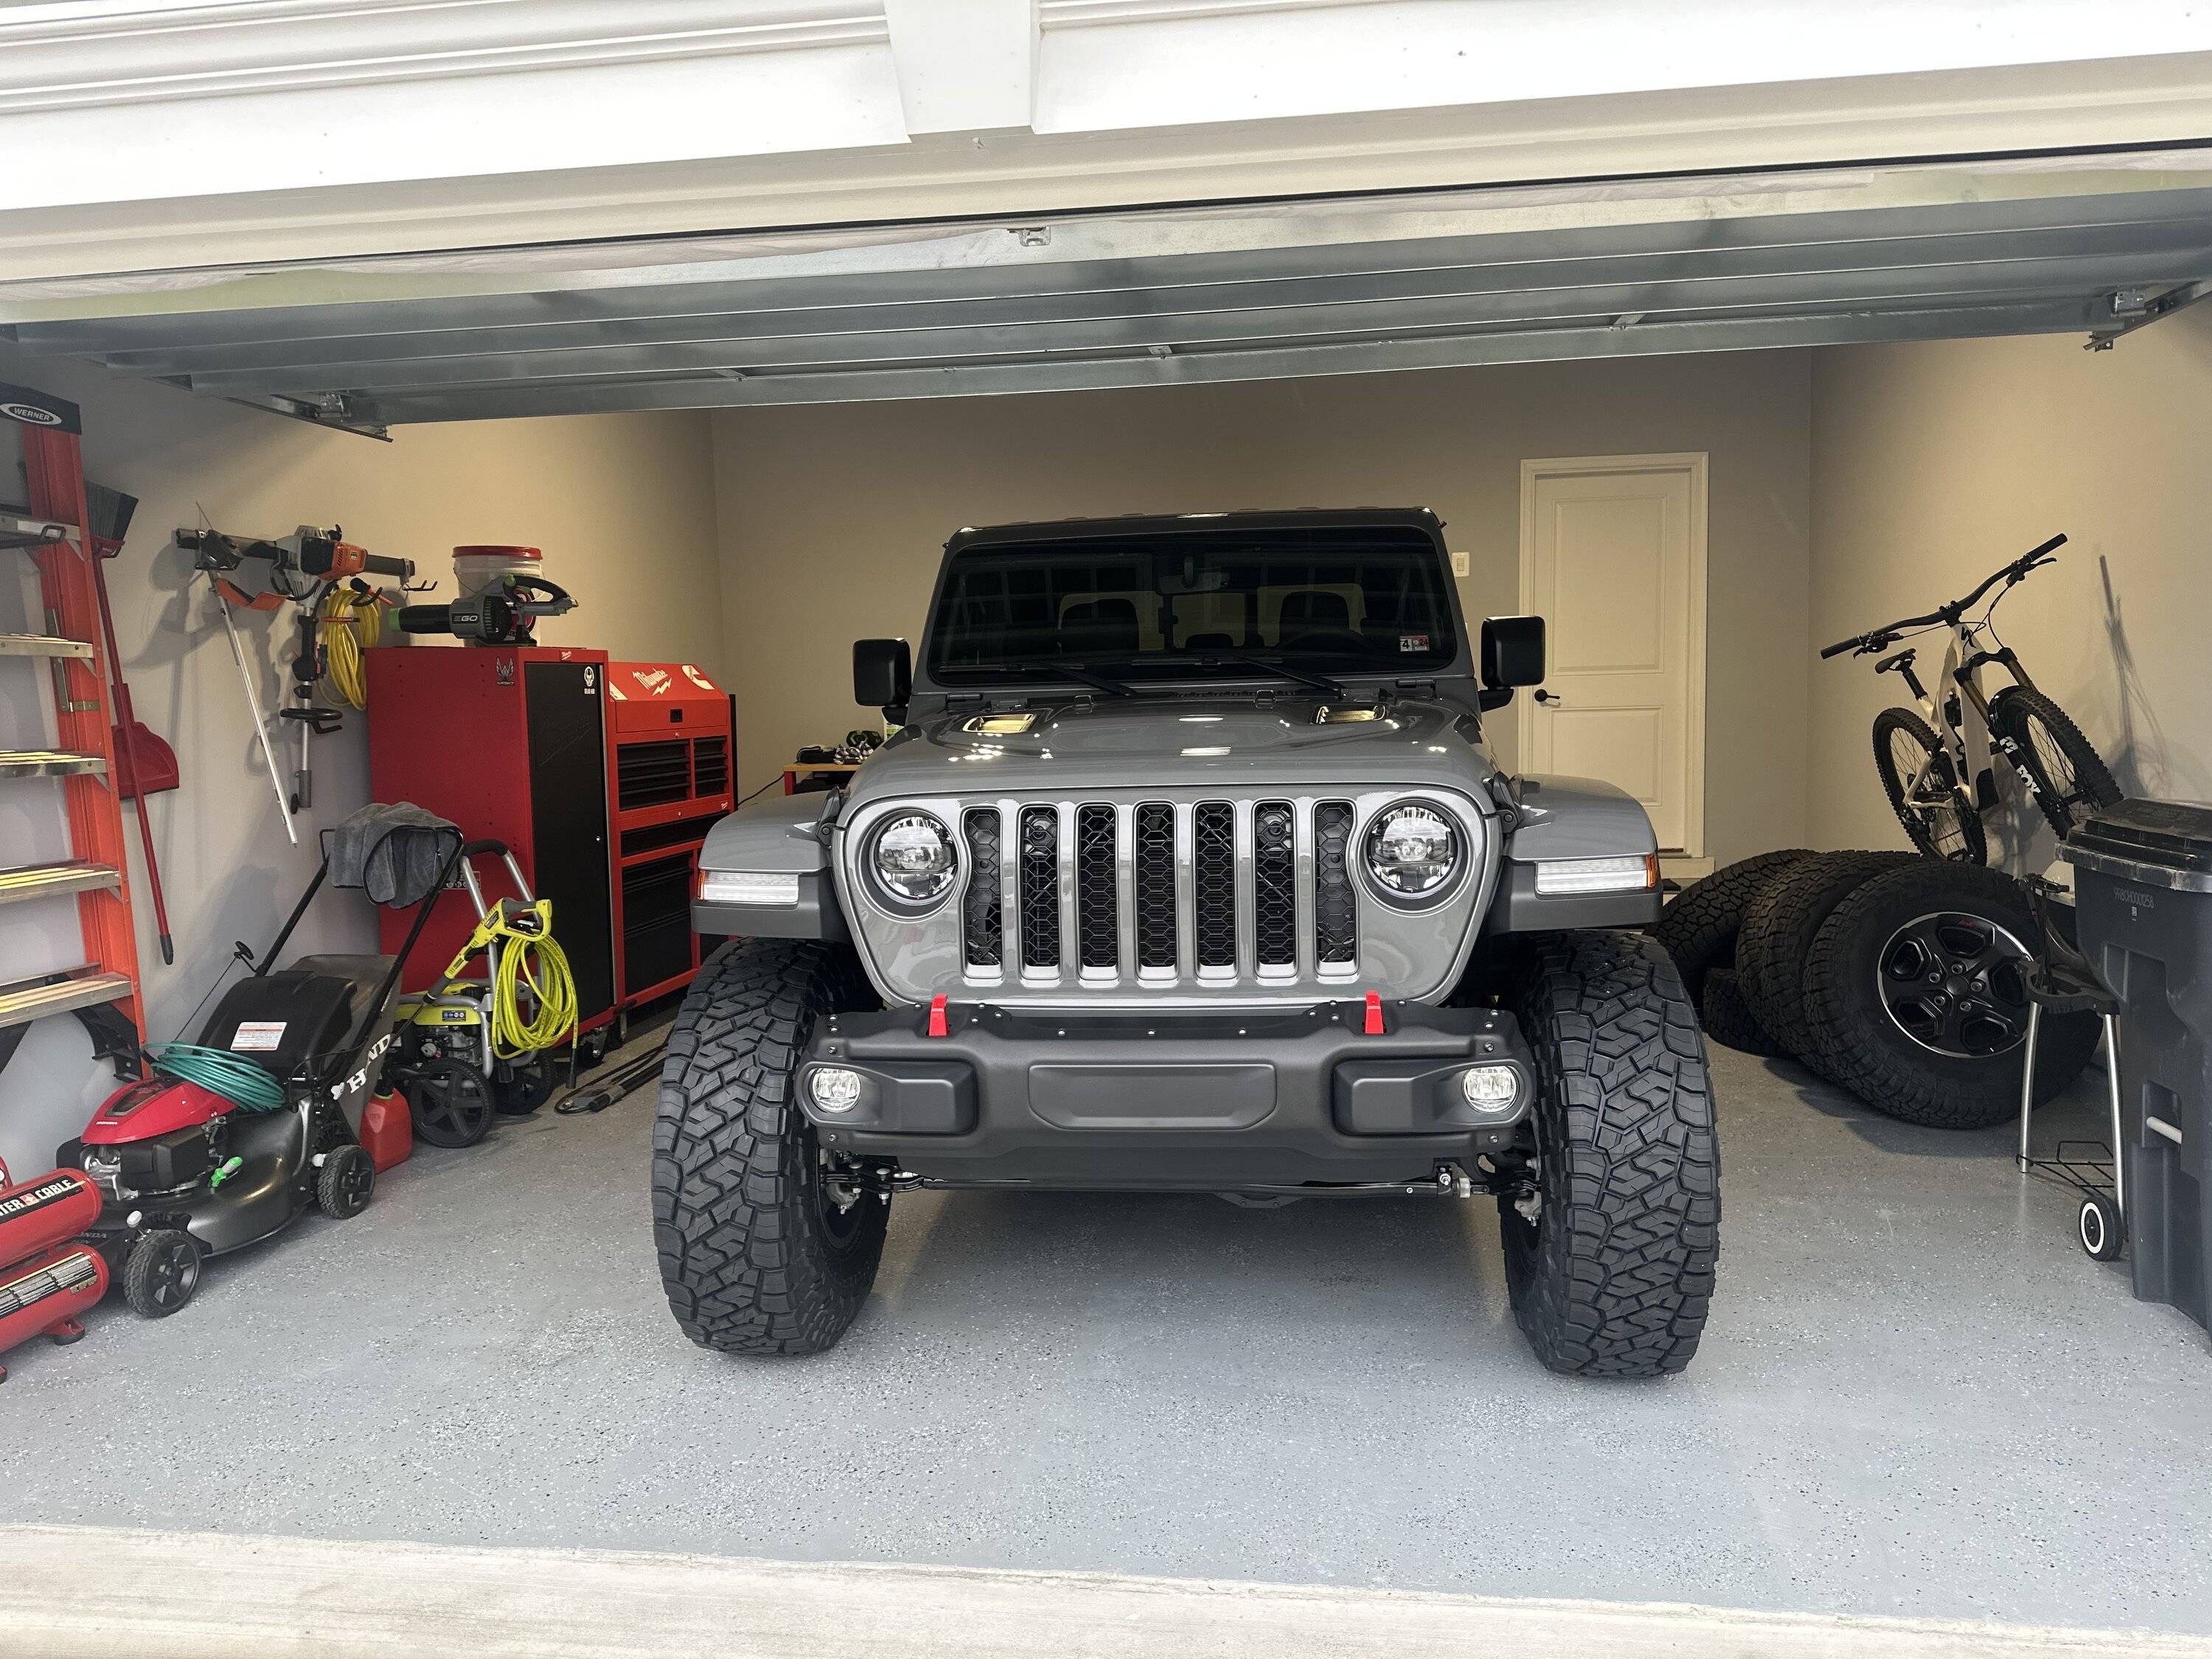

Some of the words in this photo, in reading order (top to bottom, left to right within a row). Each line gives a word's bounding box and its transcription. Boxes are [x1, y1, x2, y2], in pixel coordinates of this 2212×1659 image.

[14, 407, 51, 421] WERNER
[1402, 639, 1409, 649] 4
[2016, 764, 2042, 793] FOX
[34, 1179, 72, 1200] CABLE
